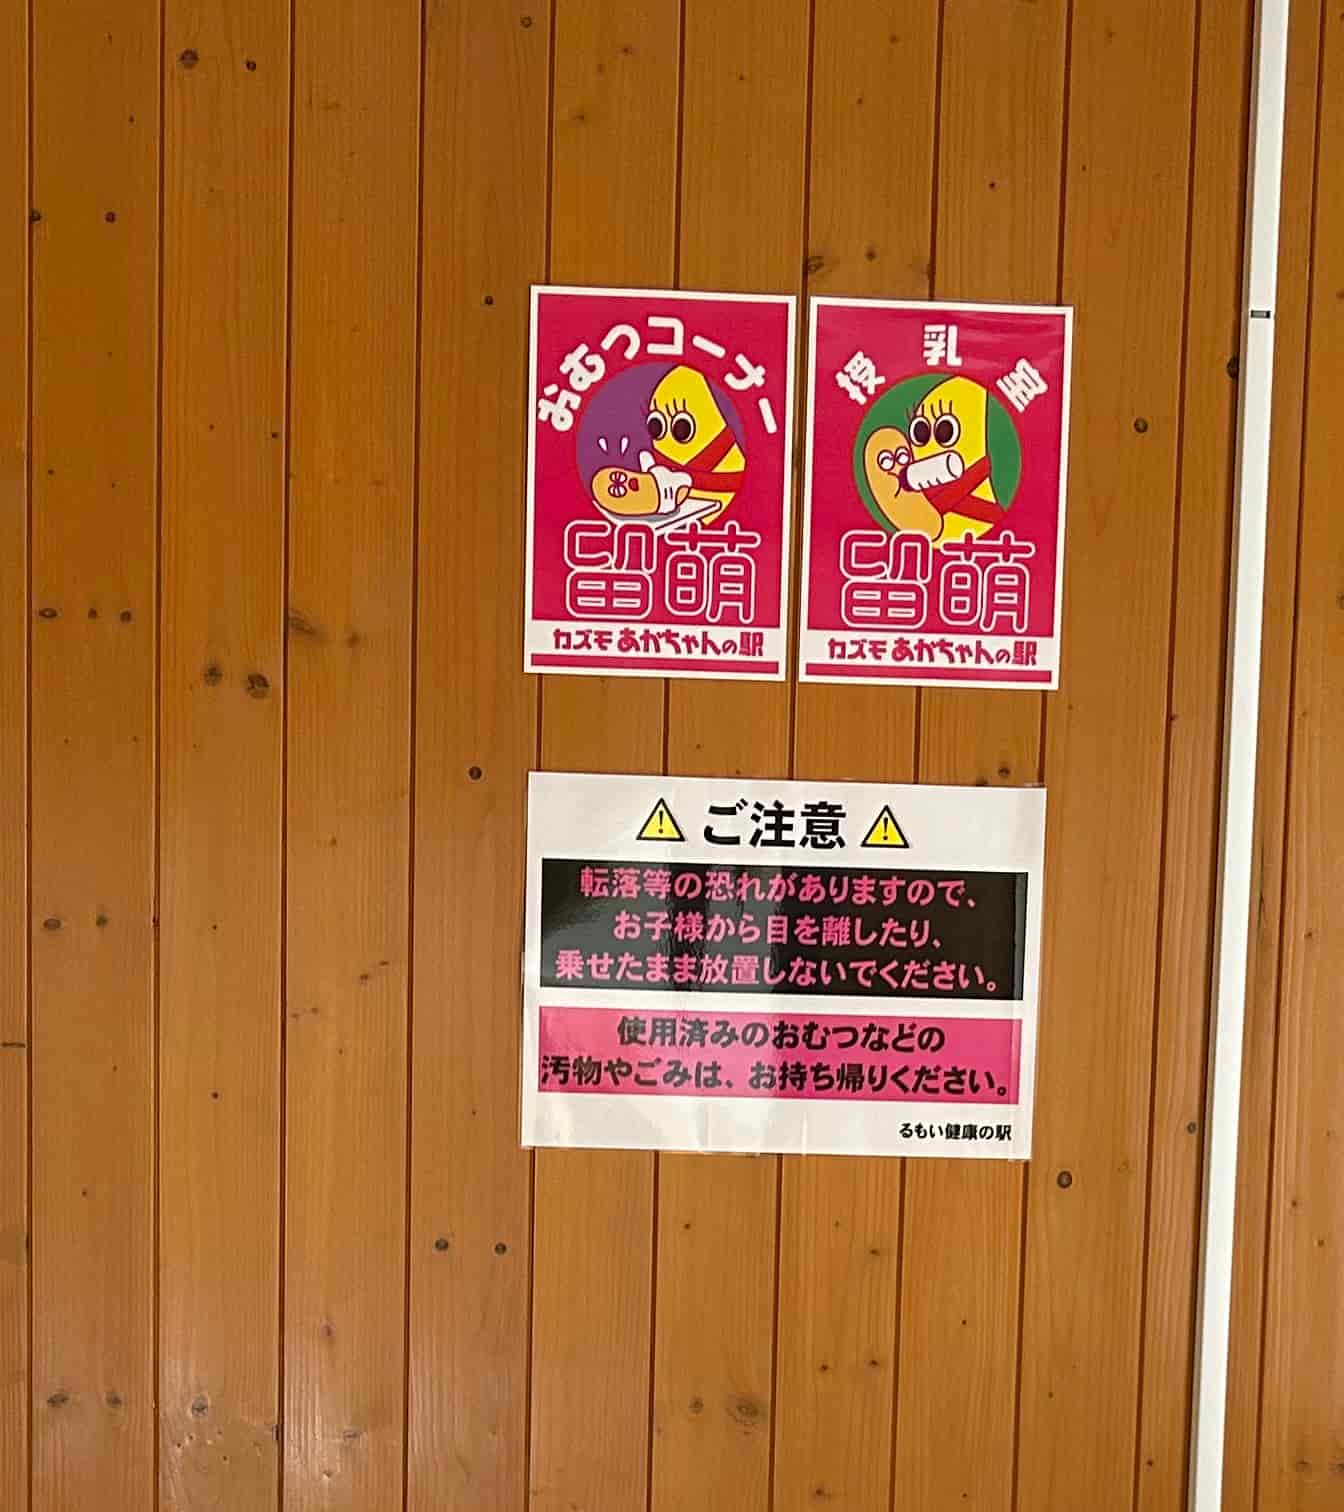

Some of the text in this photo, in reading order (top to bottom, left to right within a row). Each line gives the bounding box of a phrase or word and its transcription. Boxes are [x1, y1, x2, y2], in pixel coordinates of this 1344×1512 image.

[537, 315, 778, 433] おむつコーナー
[835, 323, 1049, 413] 授乳室
[563, 519, 760, 625] 留萌
[839, 529, 1036, 633] 留萌
[702, 799, 847, 850] ご注意
[579, 866, 978, 908] 転落等の恐れがありますので、
[612, 911, 943, 949] お子様から目を離したり、
[555, 949, 1000, 993] 乗せたまま放置しないでください。
[616, 1016, 945, 1053] 使用済みのおむつなどの
[540, 1054, 1008, 1098] 汚物やごみは、お持ち帰りください。
[899, 1122, 1012, 1141] るもい健康の駅
